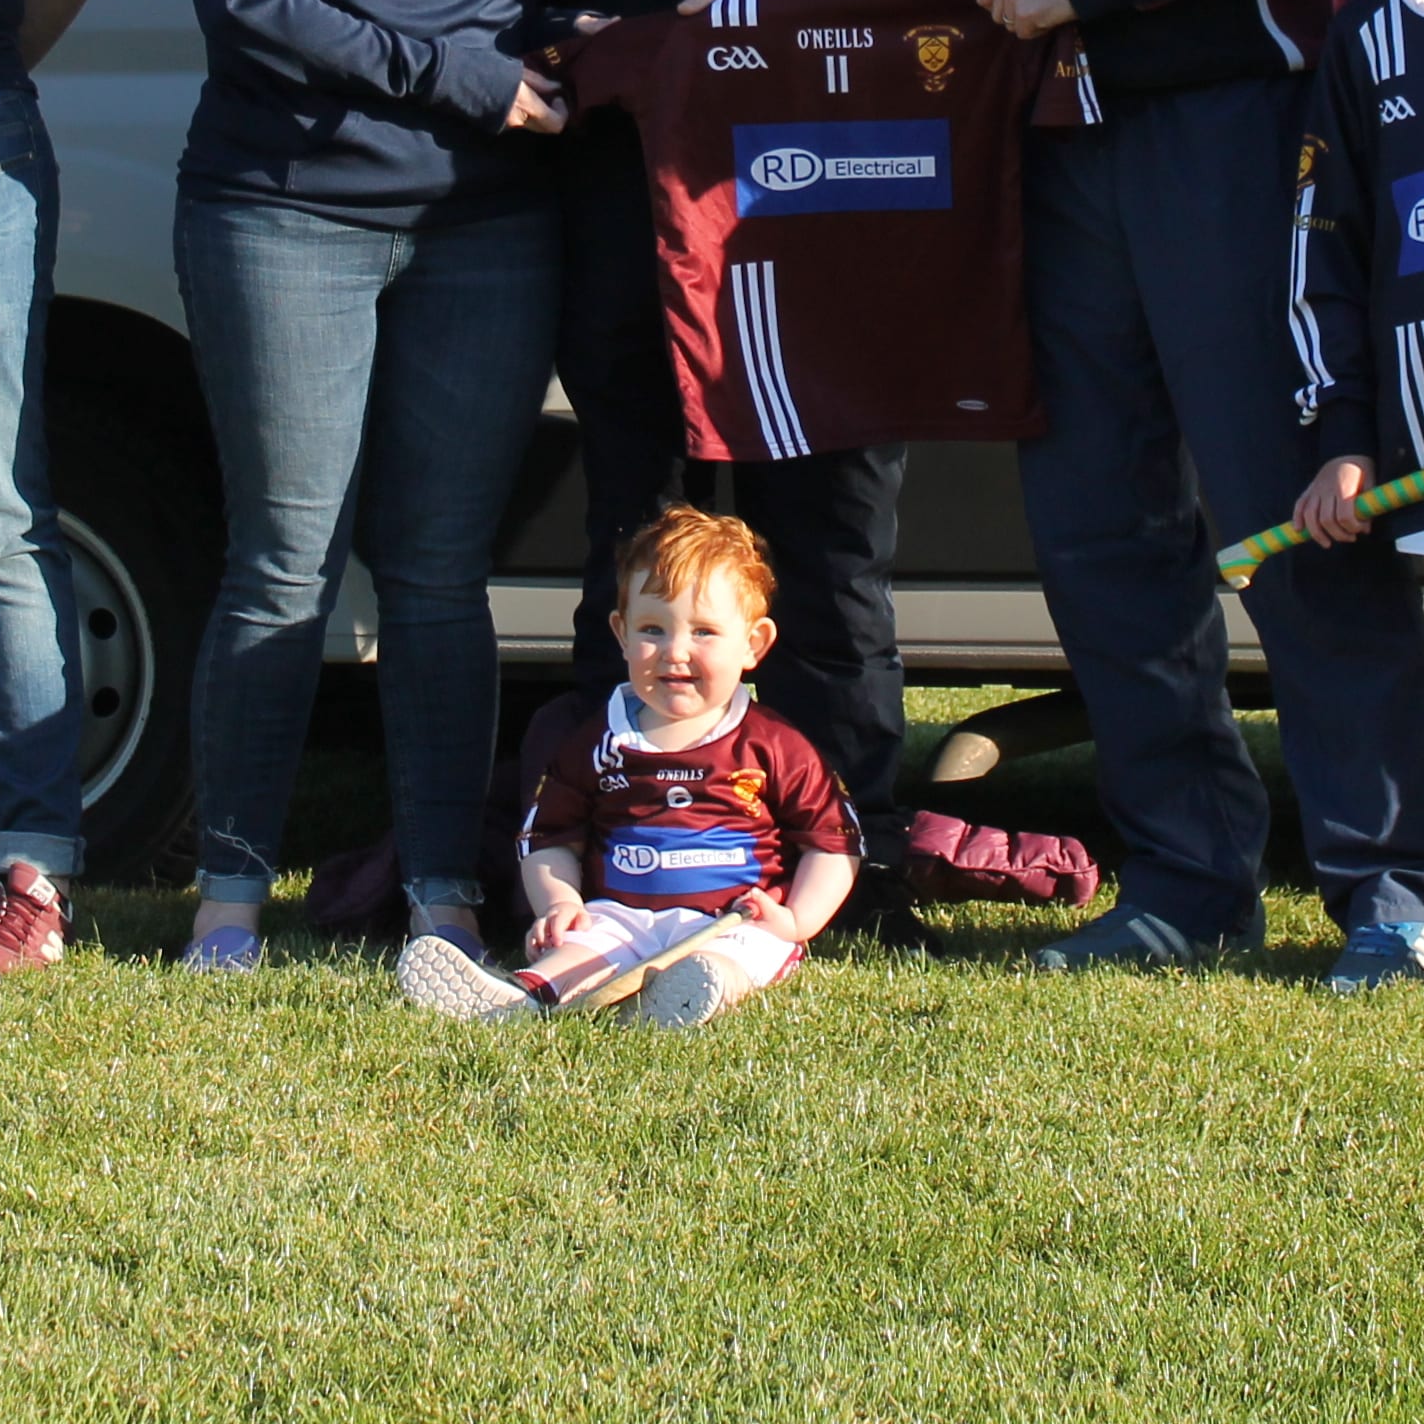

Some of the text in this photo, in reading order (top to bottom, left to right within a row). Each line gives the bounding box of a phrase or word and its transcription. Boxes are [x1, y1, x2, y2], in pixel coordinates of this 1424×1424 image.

[797, 28, 874, 49] O'NEILLS
[763, 153, 922, 185] RD Electrical
[656, 769, 704, 782] O'NEILLS
[618, 846, 654, 869] RD
